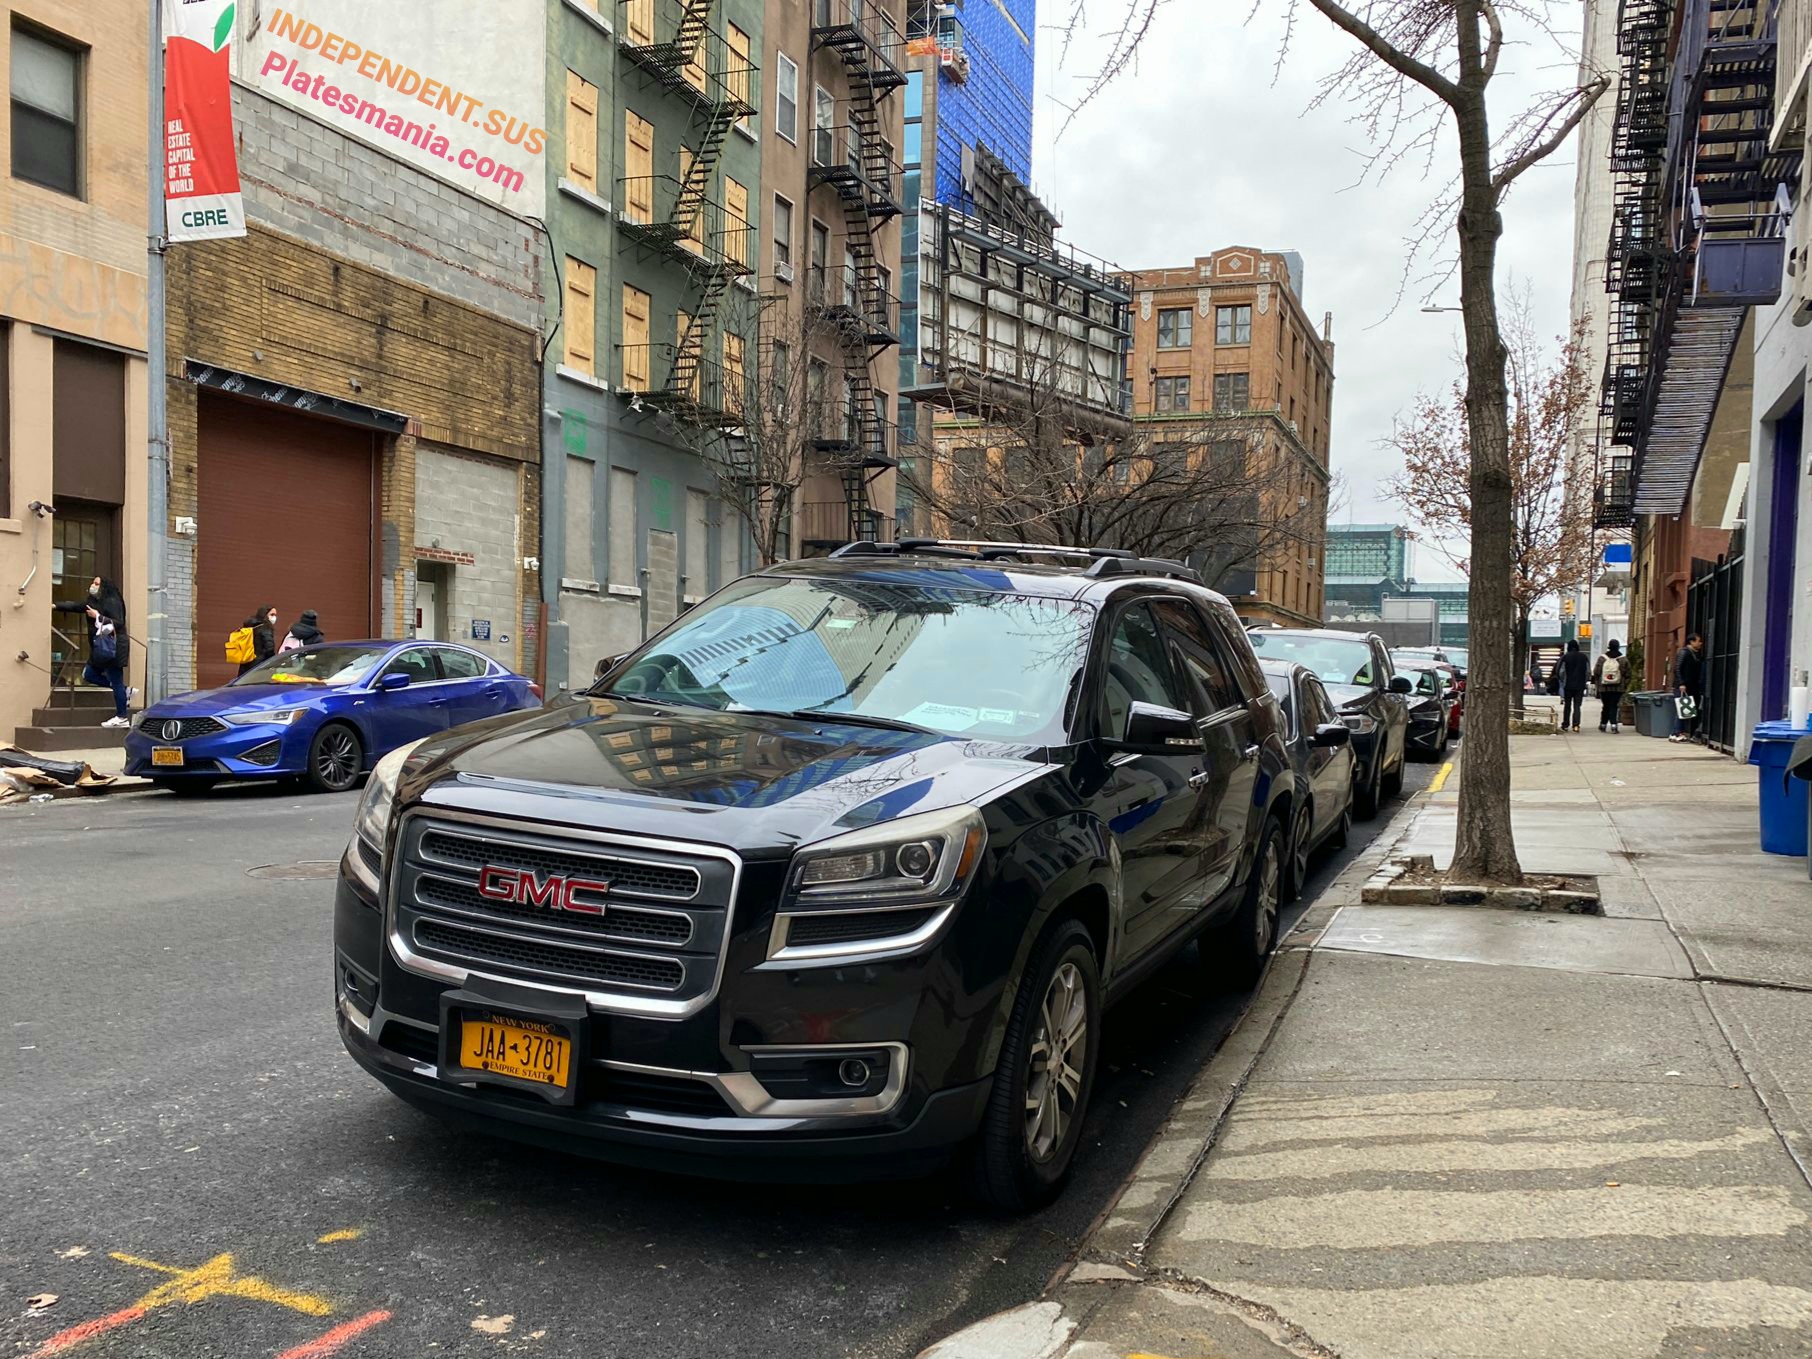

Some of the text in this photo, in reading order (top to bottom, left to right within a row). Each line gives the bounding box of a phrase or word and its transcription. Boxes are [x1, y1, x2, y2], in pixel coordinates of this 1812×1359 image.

[167, 119, 183, 134] REAL
[167, 133, 191, 149] ESTATE
[168, 148, 195, 164] CAPITAL
[168, 163, 191, 179] OF THE
[169, 178, 194, 194] WORLD
[182, 209, 228, 227] CBRE
[479, 864, 609, 916] GMC
[491, 1014, 549, 1034] NEW YORK
[473, 1026, 563, 1073] JAA 3781
[489, 1062, 548, 1080] EMPIRE STATE
